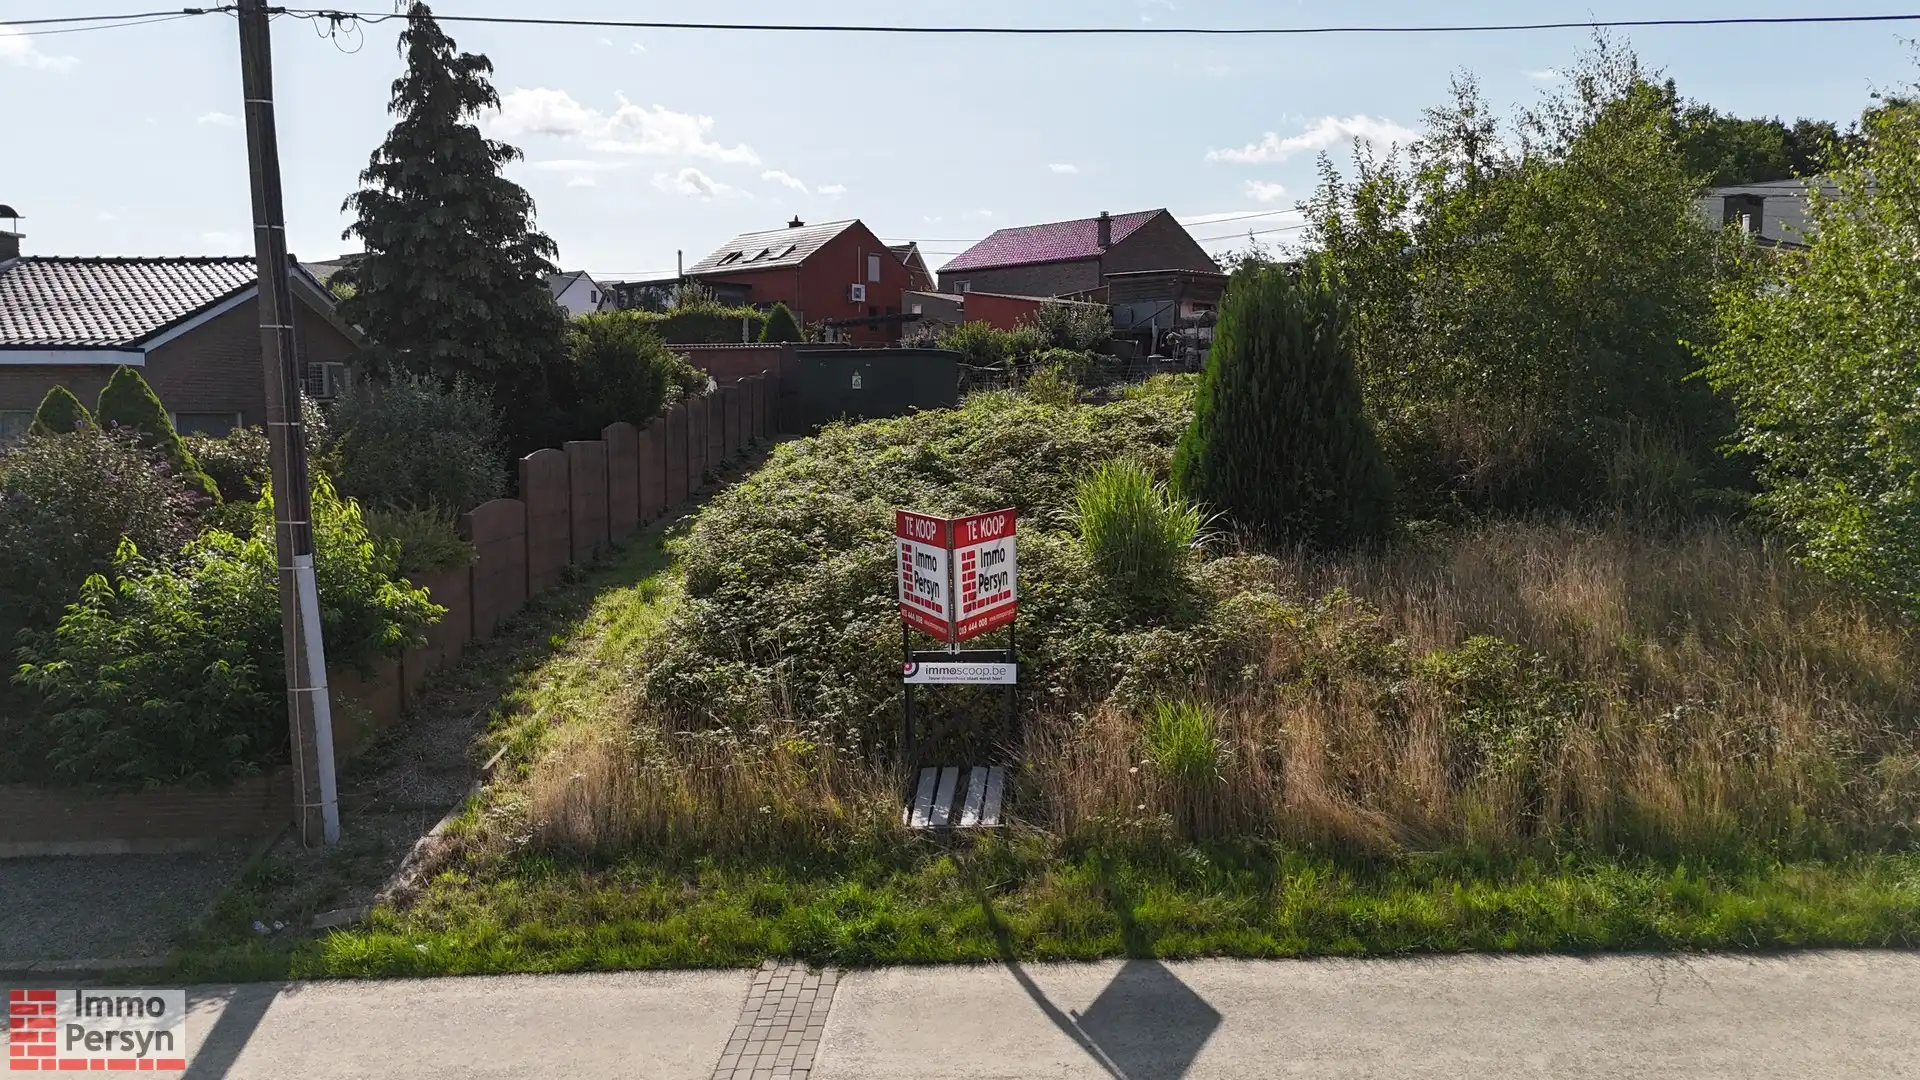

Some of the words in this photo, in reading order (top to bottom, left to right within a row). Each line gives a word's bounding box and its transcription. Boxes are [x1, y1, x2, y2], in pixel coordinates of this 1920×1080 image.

[904, 516, 914, 536] TE
[915, 518, 937, 541] KOOP
[966, 520, 978, 541] TE
[980, 515, 1005, 536] KOOP
[915, 547, 937, 572] Immo
[980, 547, 1006, 569] Immo
[914, 570, 940, 601] Persyn
[978, 571, 1008, 594] Persyn
[925, 664, 1007, 676] immoscoop.be
